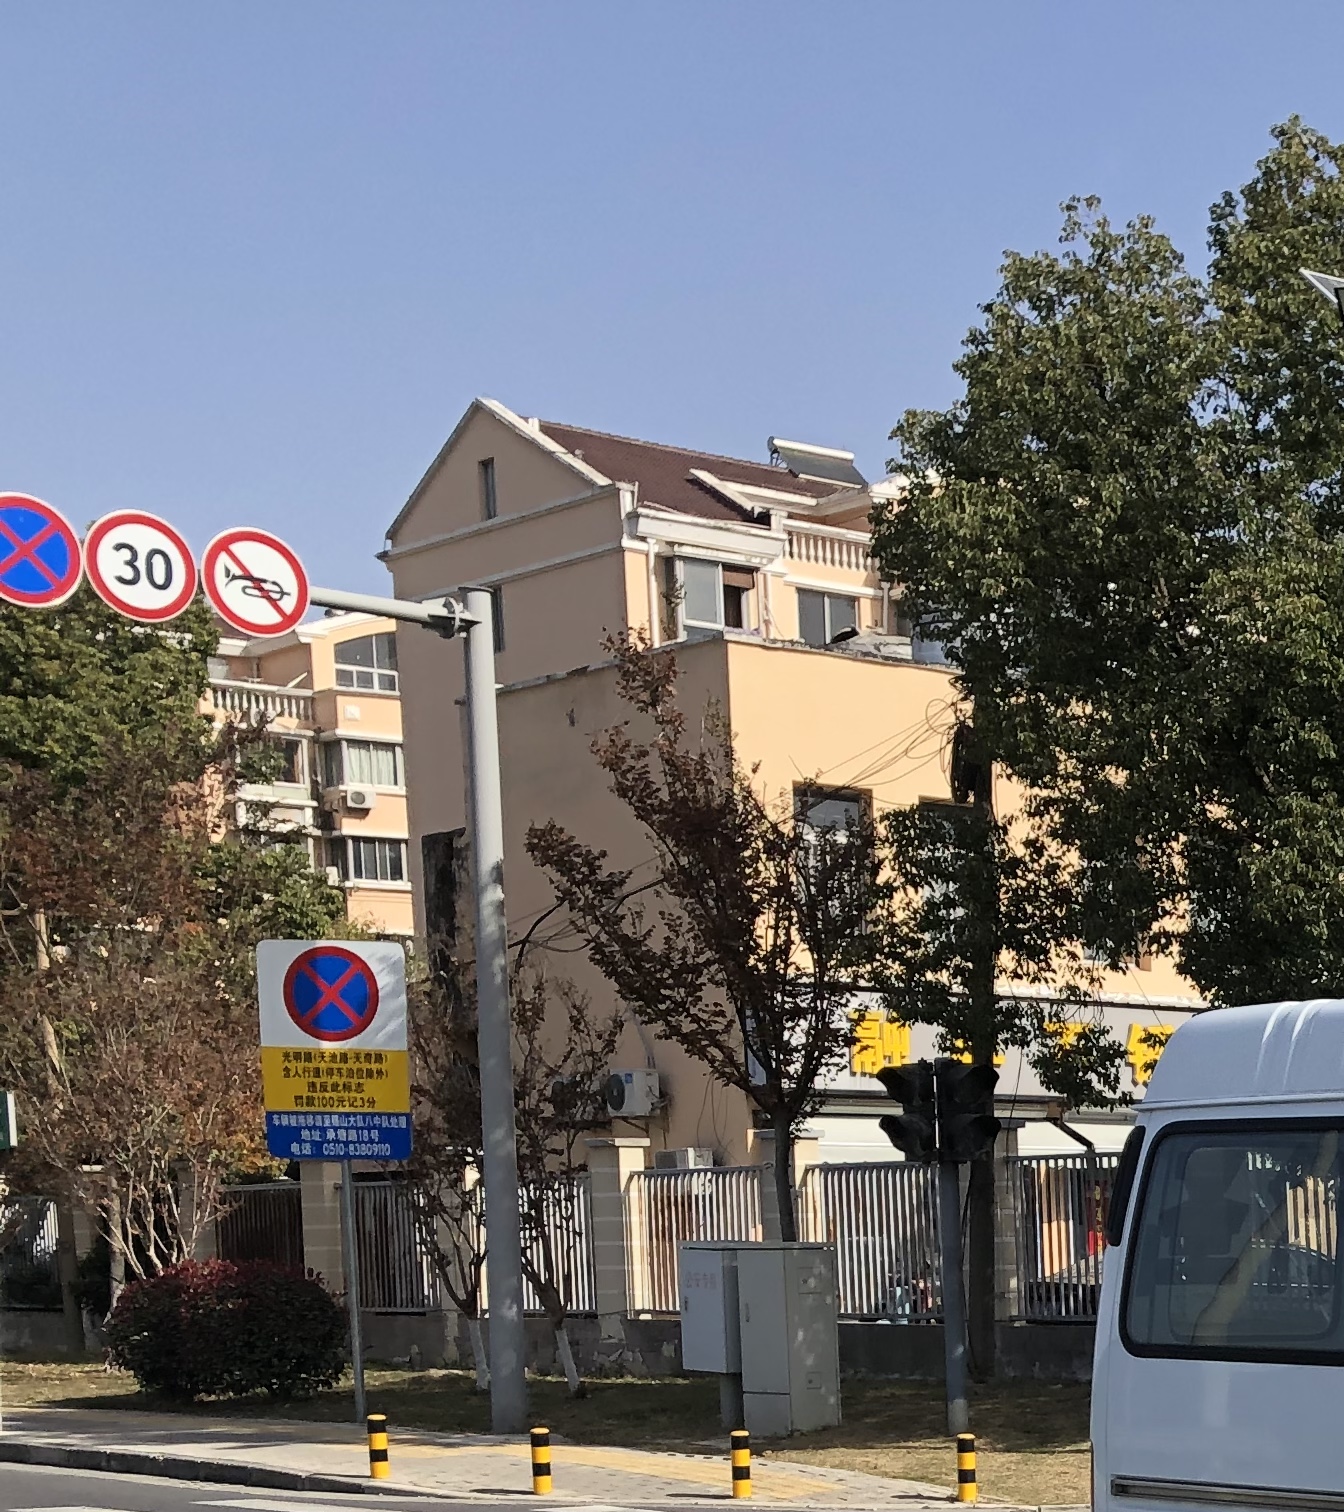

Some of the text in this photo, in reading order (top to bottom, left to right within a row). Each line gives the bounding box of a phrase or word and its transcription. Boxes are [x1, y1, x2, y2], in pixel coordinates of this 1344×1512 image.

[112, 542, 173, 591] 30
[307, 1081, 365, 1094] 违反此标志
[294, 1095, 376, 1108] 罚款100元记3分
